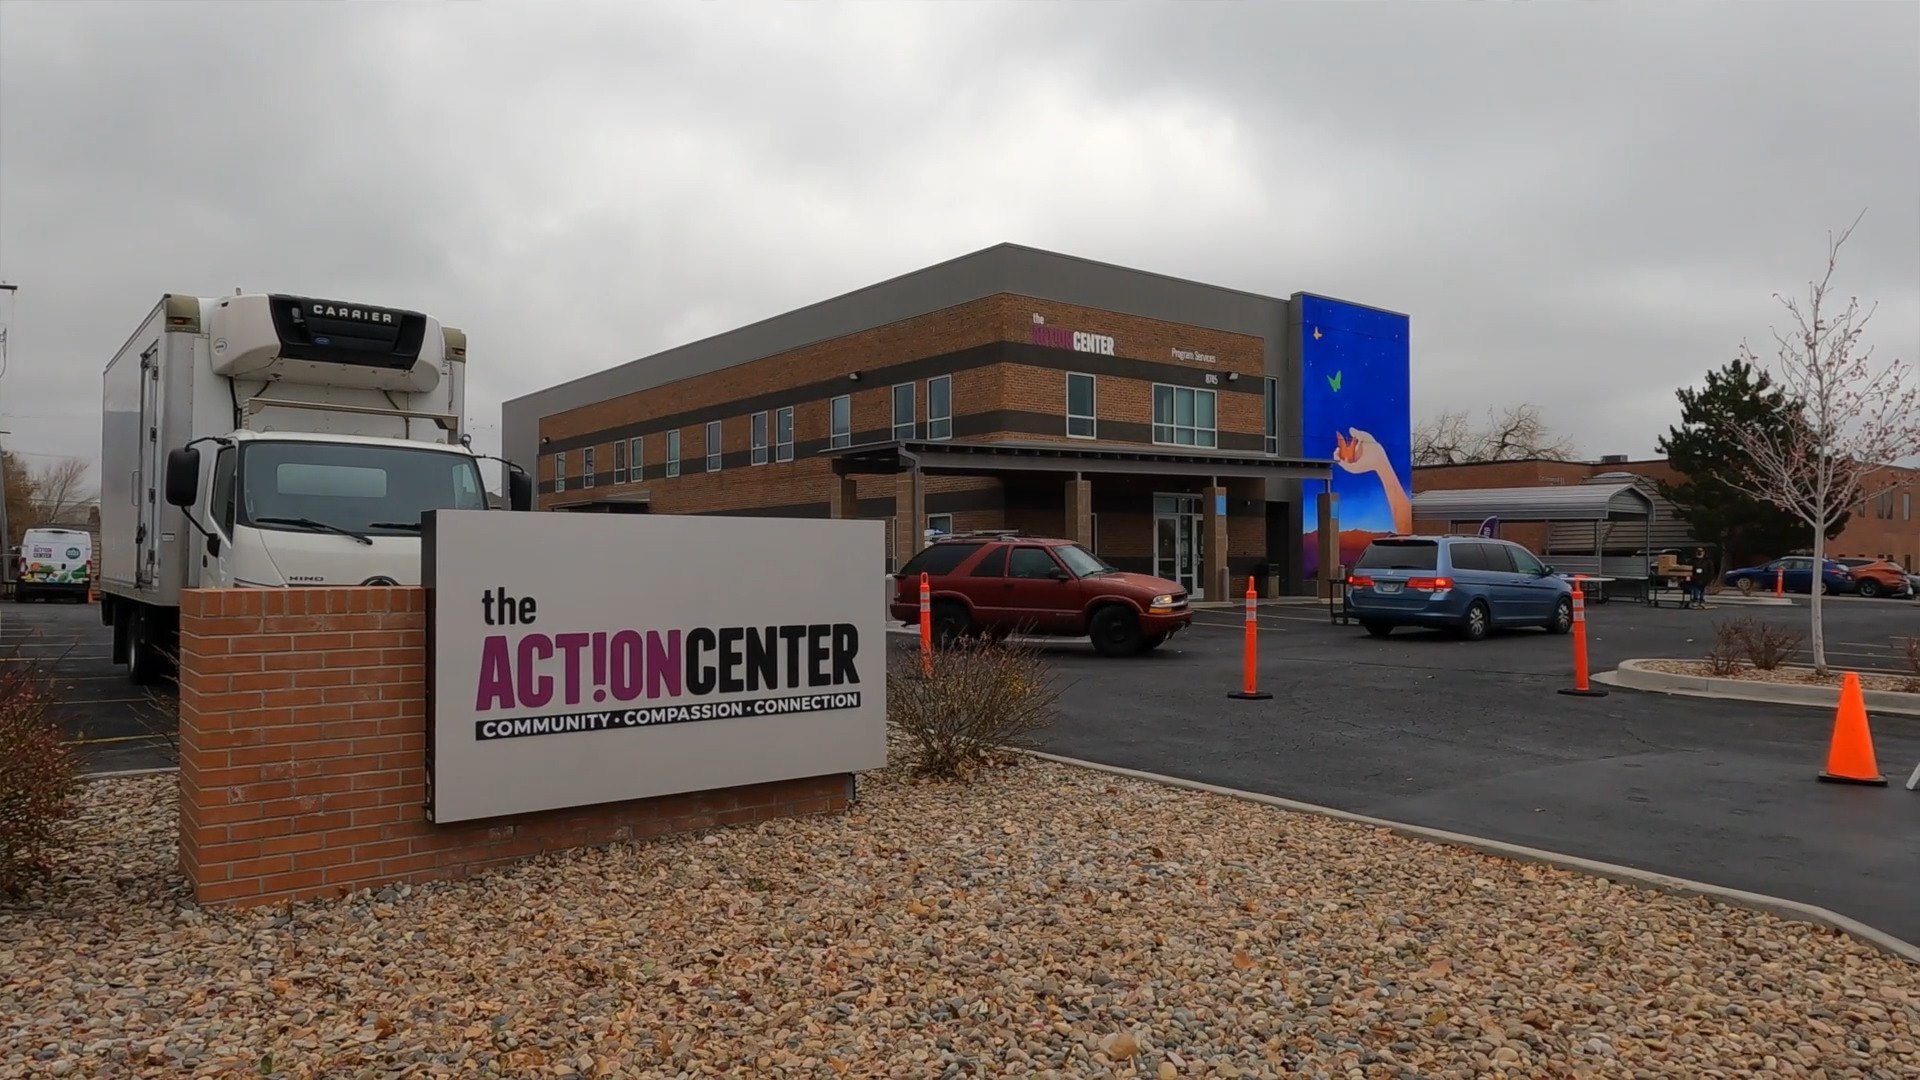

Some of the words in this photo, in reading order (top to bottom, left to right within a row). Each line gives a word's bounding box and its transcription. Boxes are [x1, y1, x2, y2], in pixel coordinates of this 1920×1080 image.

[313, 304, 392, 323] CARRIER
[1033, 313, 1045, 325] the
[1172, 347, 1194, 361] Program
[1194, 351, 1216, 363] Services
[482, 587, 537, 626] the
[482, 712, 610, 738] COMMUNITY
[623, 702, 743, 725] COMPASSION
[754, 692, 858, 714] CONNECTION
